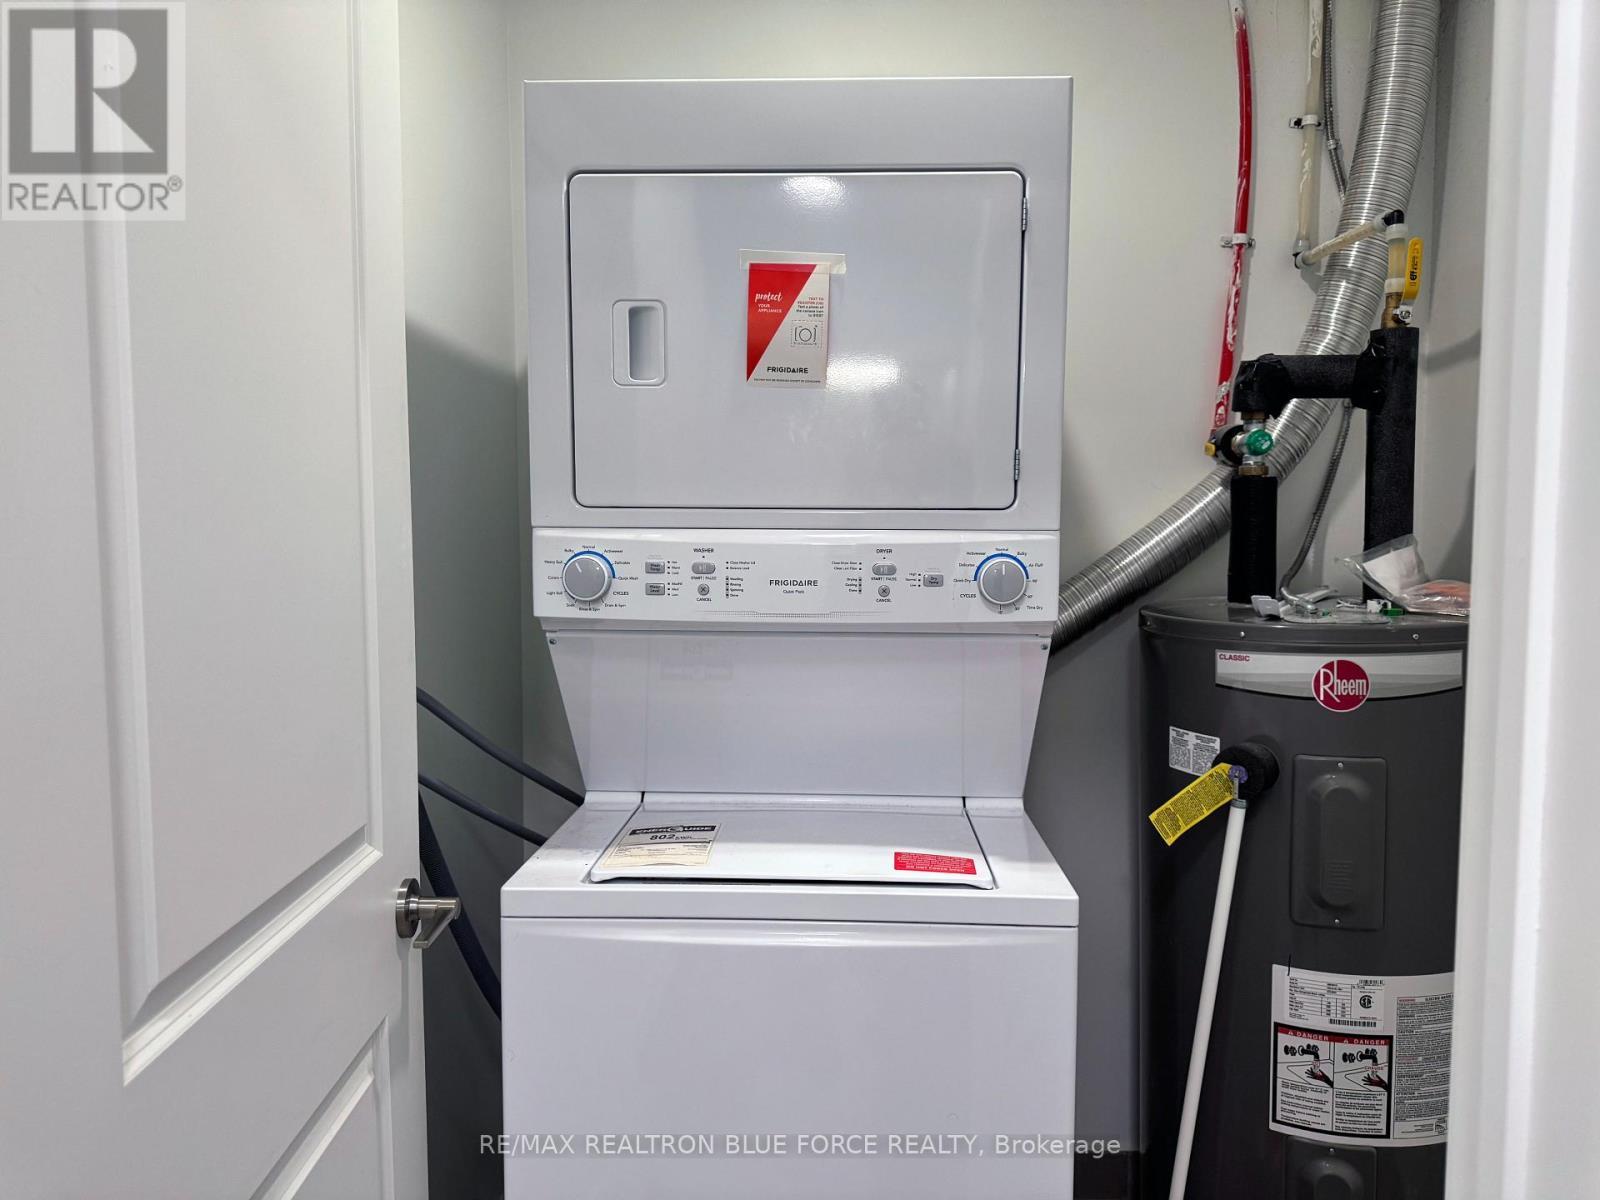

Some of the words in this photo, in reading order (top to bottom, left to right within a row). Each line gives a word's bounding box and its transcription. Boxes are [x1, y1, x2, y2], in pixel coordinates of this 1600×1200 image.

[754, 292, 783, 303] protect
[1218, 653, 1250, 662] CLASSIC
[1319, 660, 1367, 703] Rheem
[1296, 1031, 1329, 1041] DANGER
